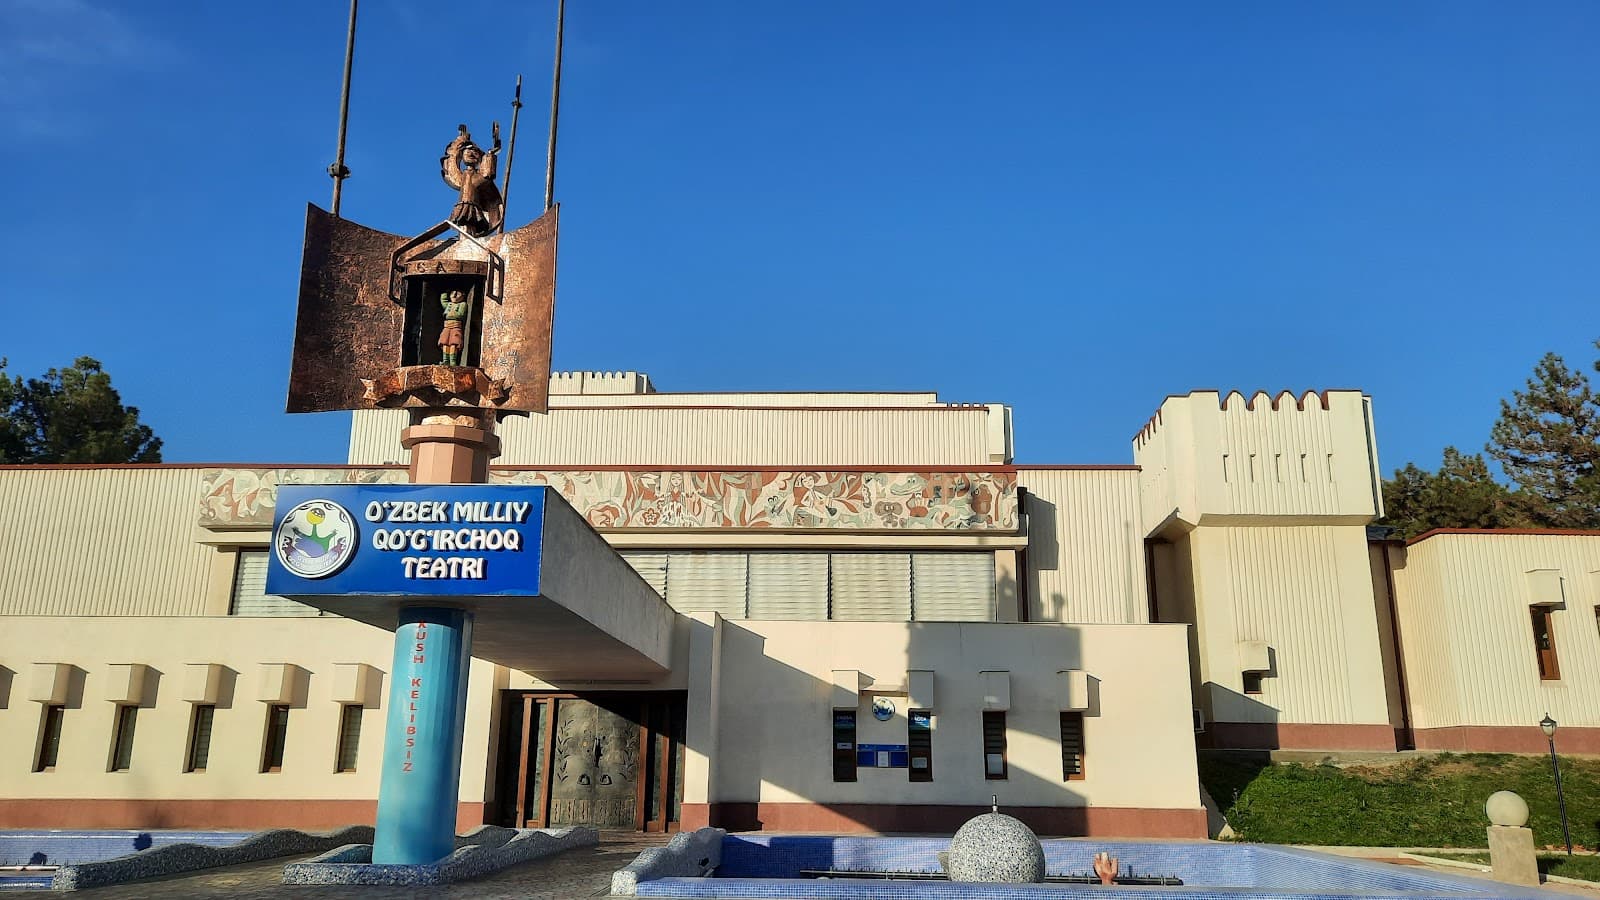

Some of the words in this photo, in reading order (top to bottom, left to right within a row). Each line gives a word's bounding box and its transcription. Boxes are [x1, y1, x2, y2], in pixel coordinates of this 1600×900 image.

[365, 500, 449, 523] O‘ZBEK
[452, 501, 529, 522] MILLIY
[372, 528, 520, 551] QO‘G‘IRCHOQ
[401, 556, 484, 579] TEATRI
[402, 678, 421, 772] KELIBSIZ
